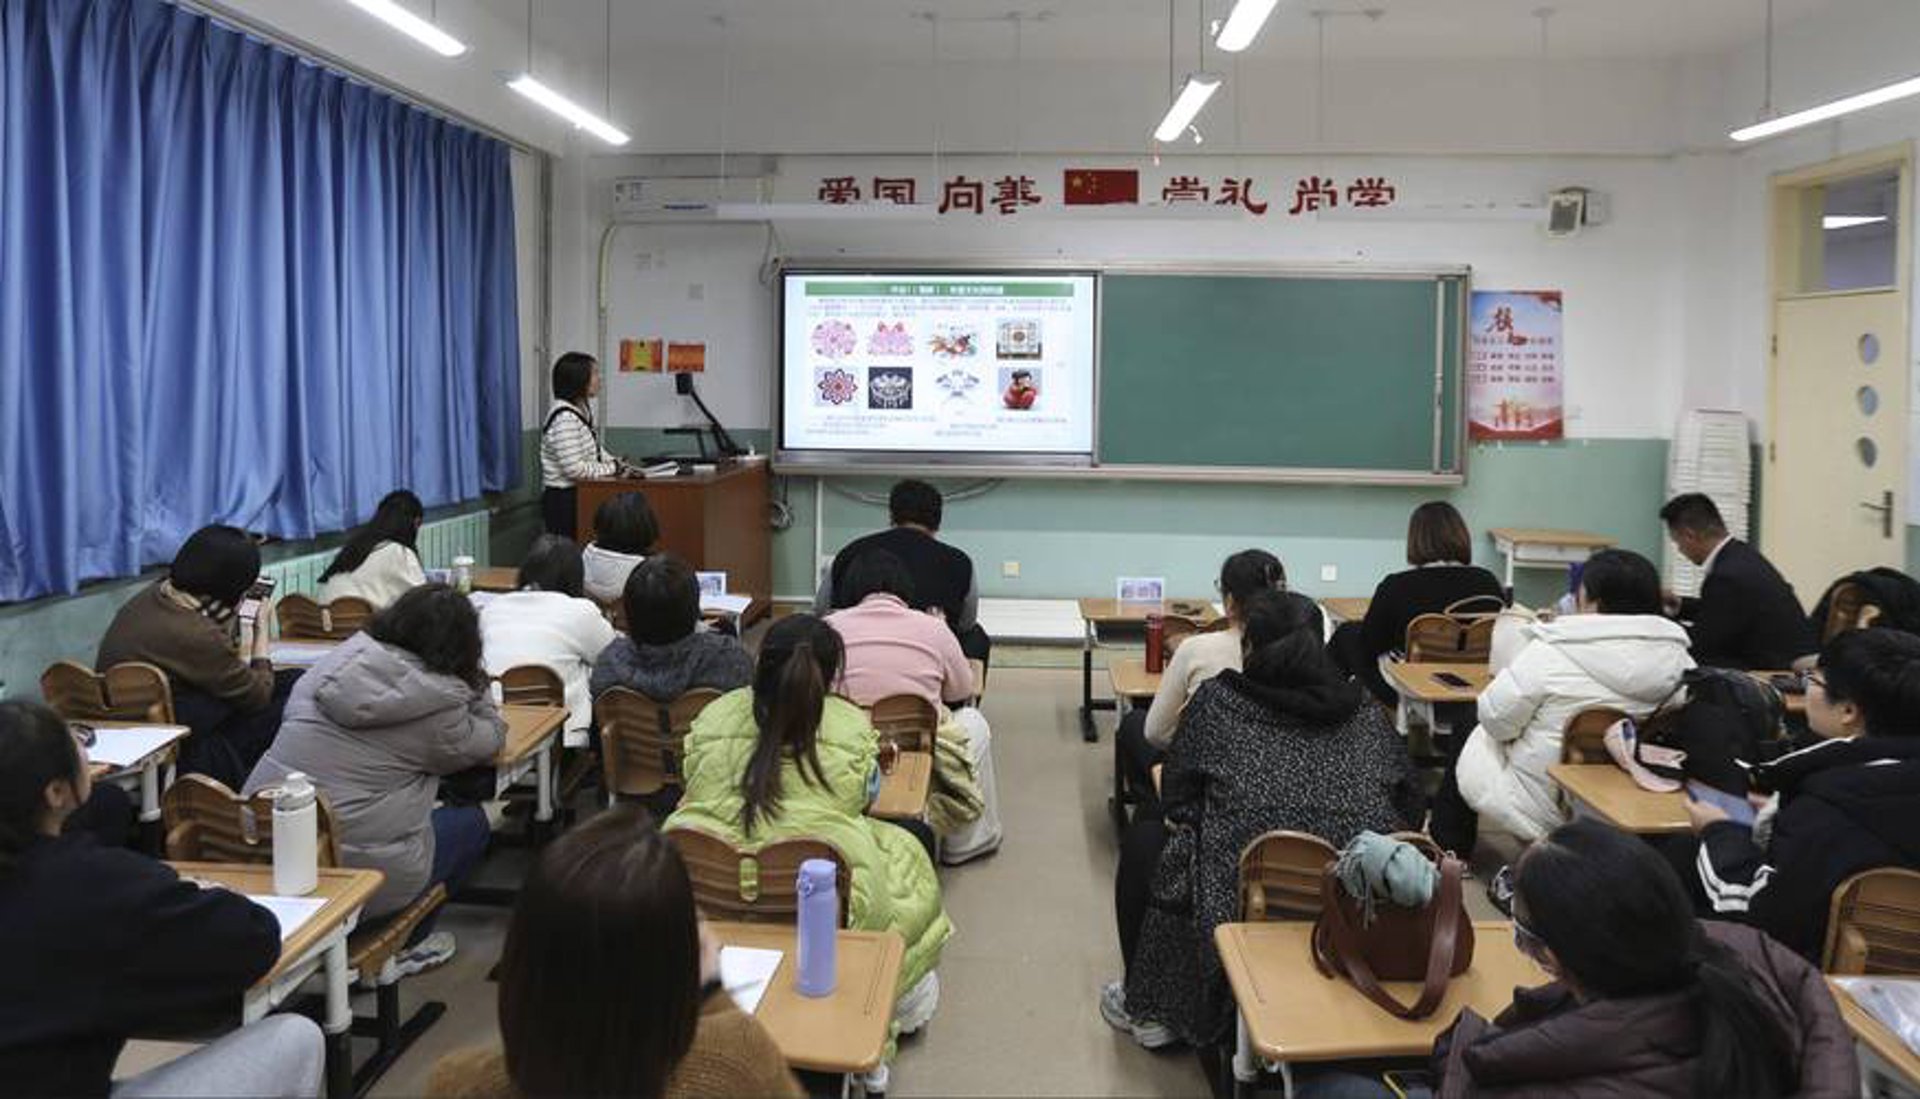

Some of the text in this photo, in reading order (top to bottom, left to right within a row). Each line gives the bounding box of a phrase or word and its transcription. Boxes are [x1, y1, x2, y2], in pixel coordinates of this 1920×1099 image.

[938, 176, 1041, 214] 向善
[1163, 176, 1268, 215] 崇礼
[1289, 176, 1396, 215] 尚学
